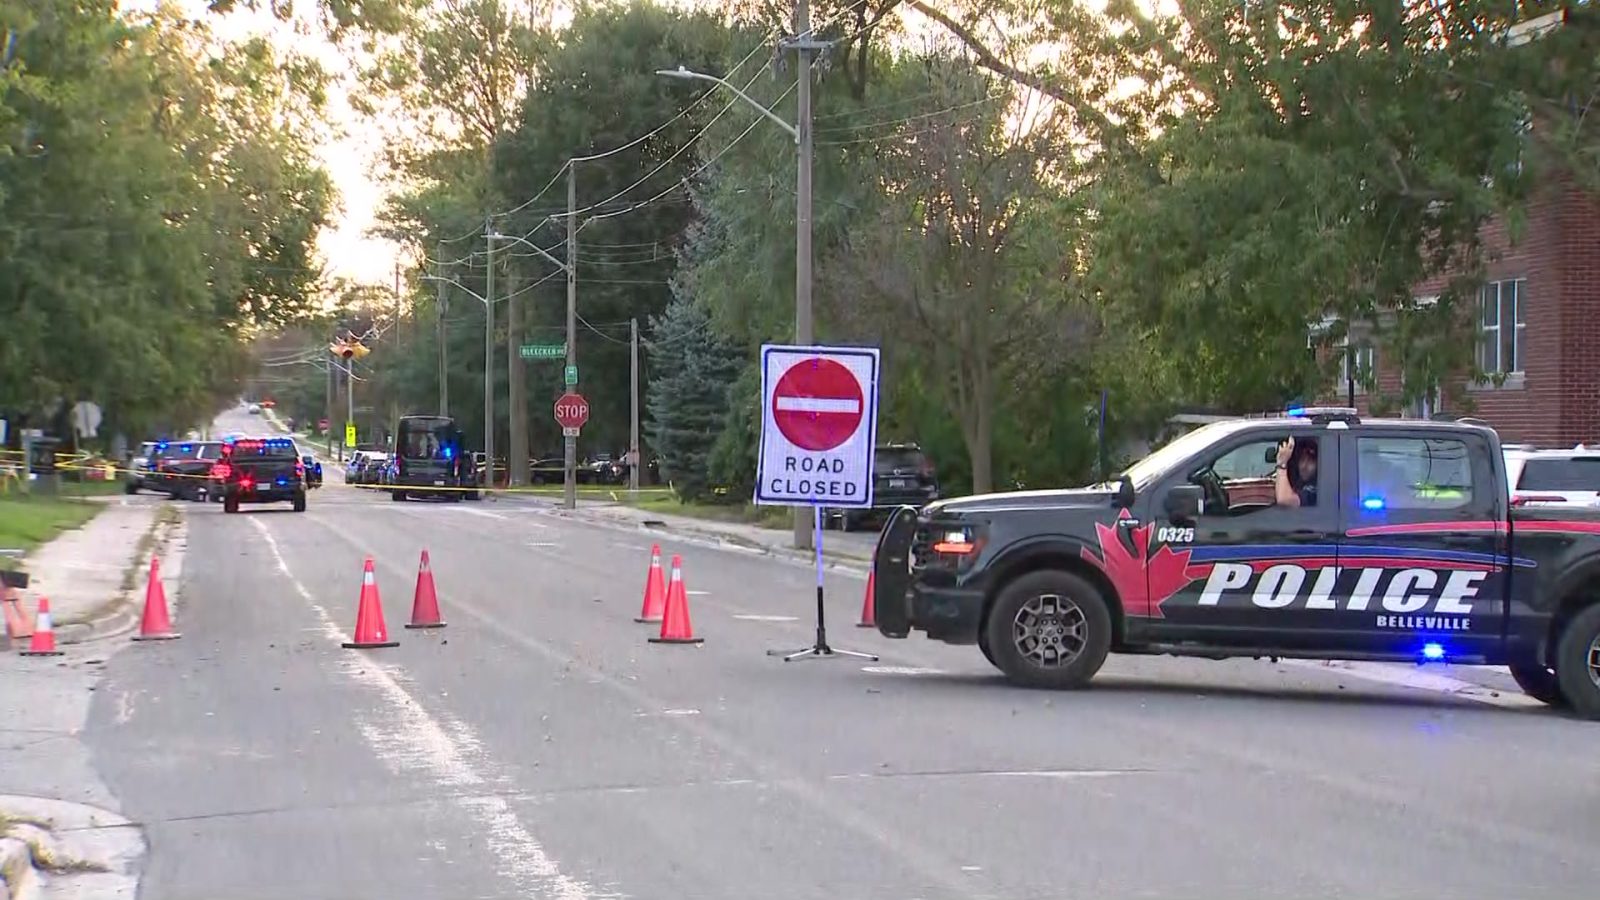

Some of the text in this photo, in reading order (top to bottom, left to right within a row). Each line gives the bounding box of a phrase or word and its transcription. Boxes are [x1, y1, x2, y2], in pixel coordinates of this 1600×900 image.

[557, 405, 587, 418] STOP
[785, 456, 844, 473] ROAD
[771, 479, 856, 496] CLOSED
[1157, 527, 1194, 542] 0325
[1197, 563, 1488, 614] POLICE
[1376, 615, 1471, 630] BELLEVILLE
